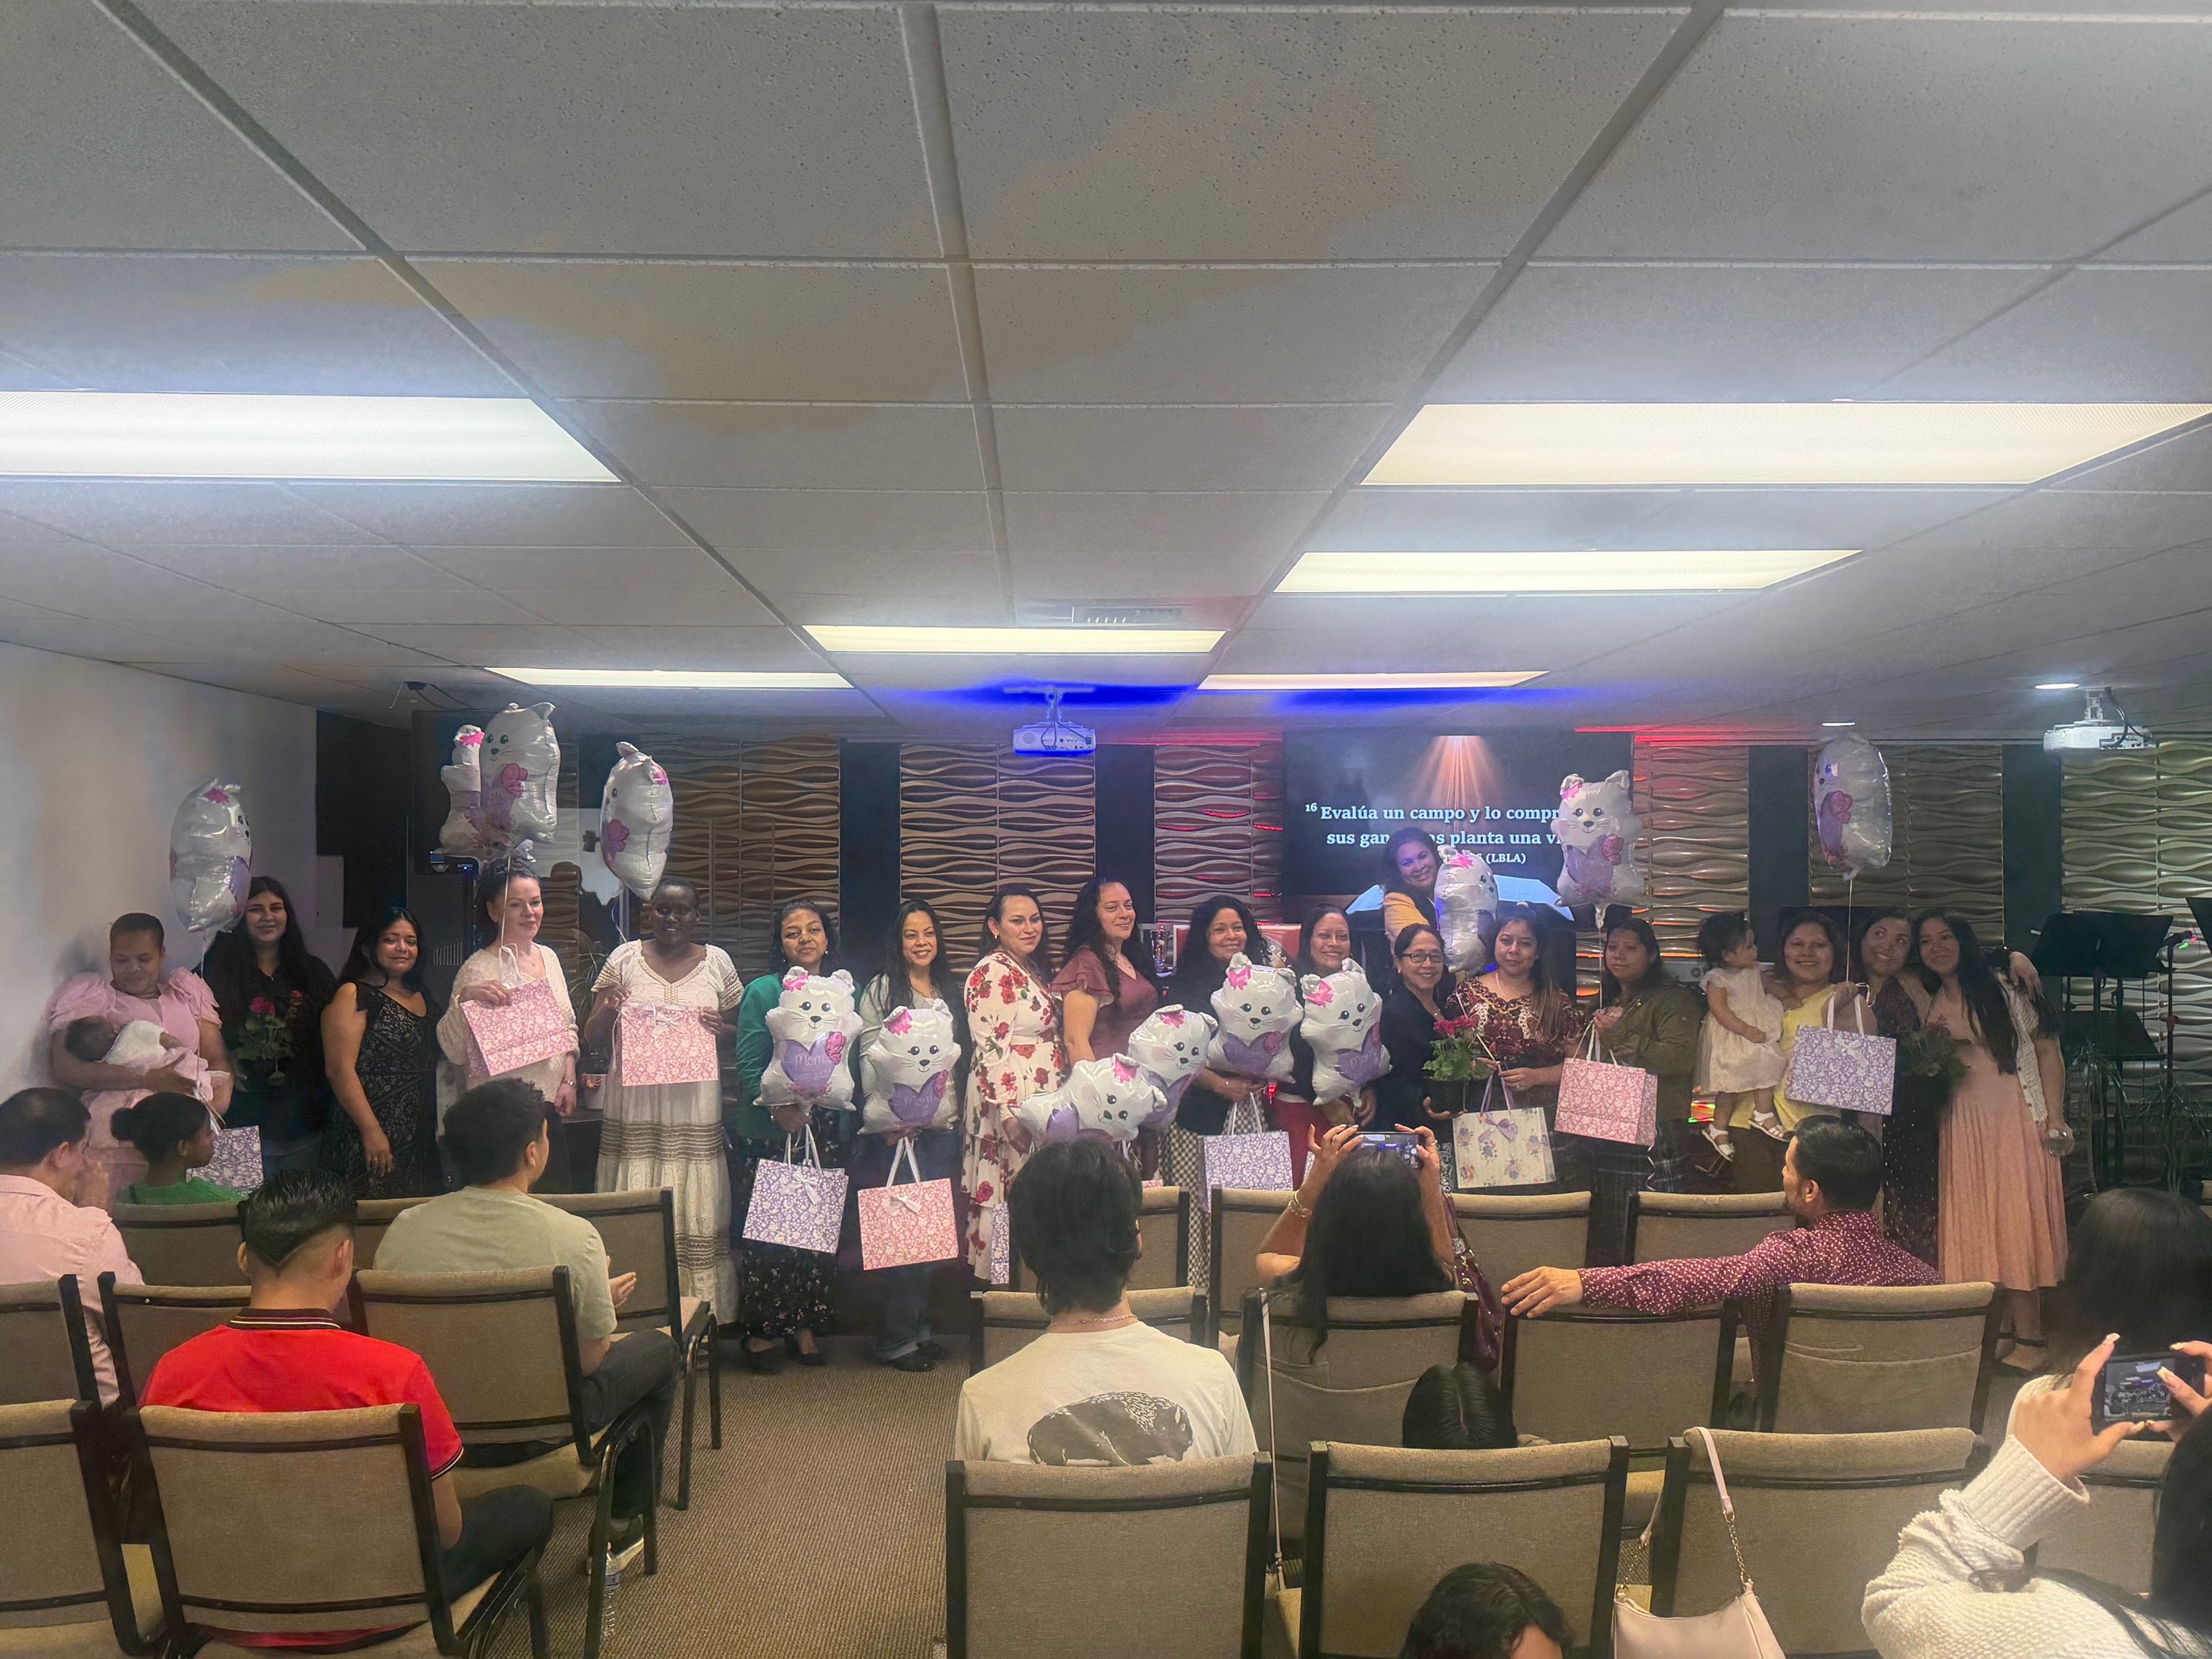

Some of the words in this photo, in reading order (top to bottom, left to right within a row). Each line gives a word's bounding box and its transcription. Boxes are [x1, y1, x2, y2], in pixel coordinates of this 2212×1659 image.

[1305, 803, 1318, 812] 16
[1320, 806, 1379, 820] Evalúa
[1383, 809, 1405, 820] un
[1410, 809, 1465, 823] campo
[1469, 809, 1480, 823] y
[1485, 806, 1502, 820] lo
[1506, 809, 1560, 823] compr
[1326, 833, 1356, 844] sus
[1450, 831, 1505, 848] planta
[1509, 833, 1542, 844] una
[1485, 853, 1526, 864] (LBLA)
